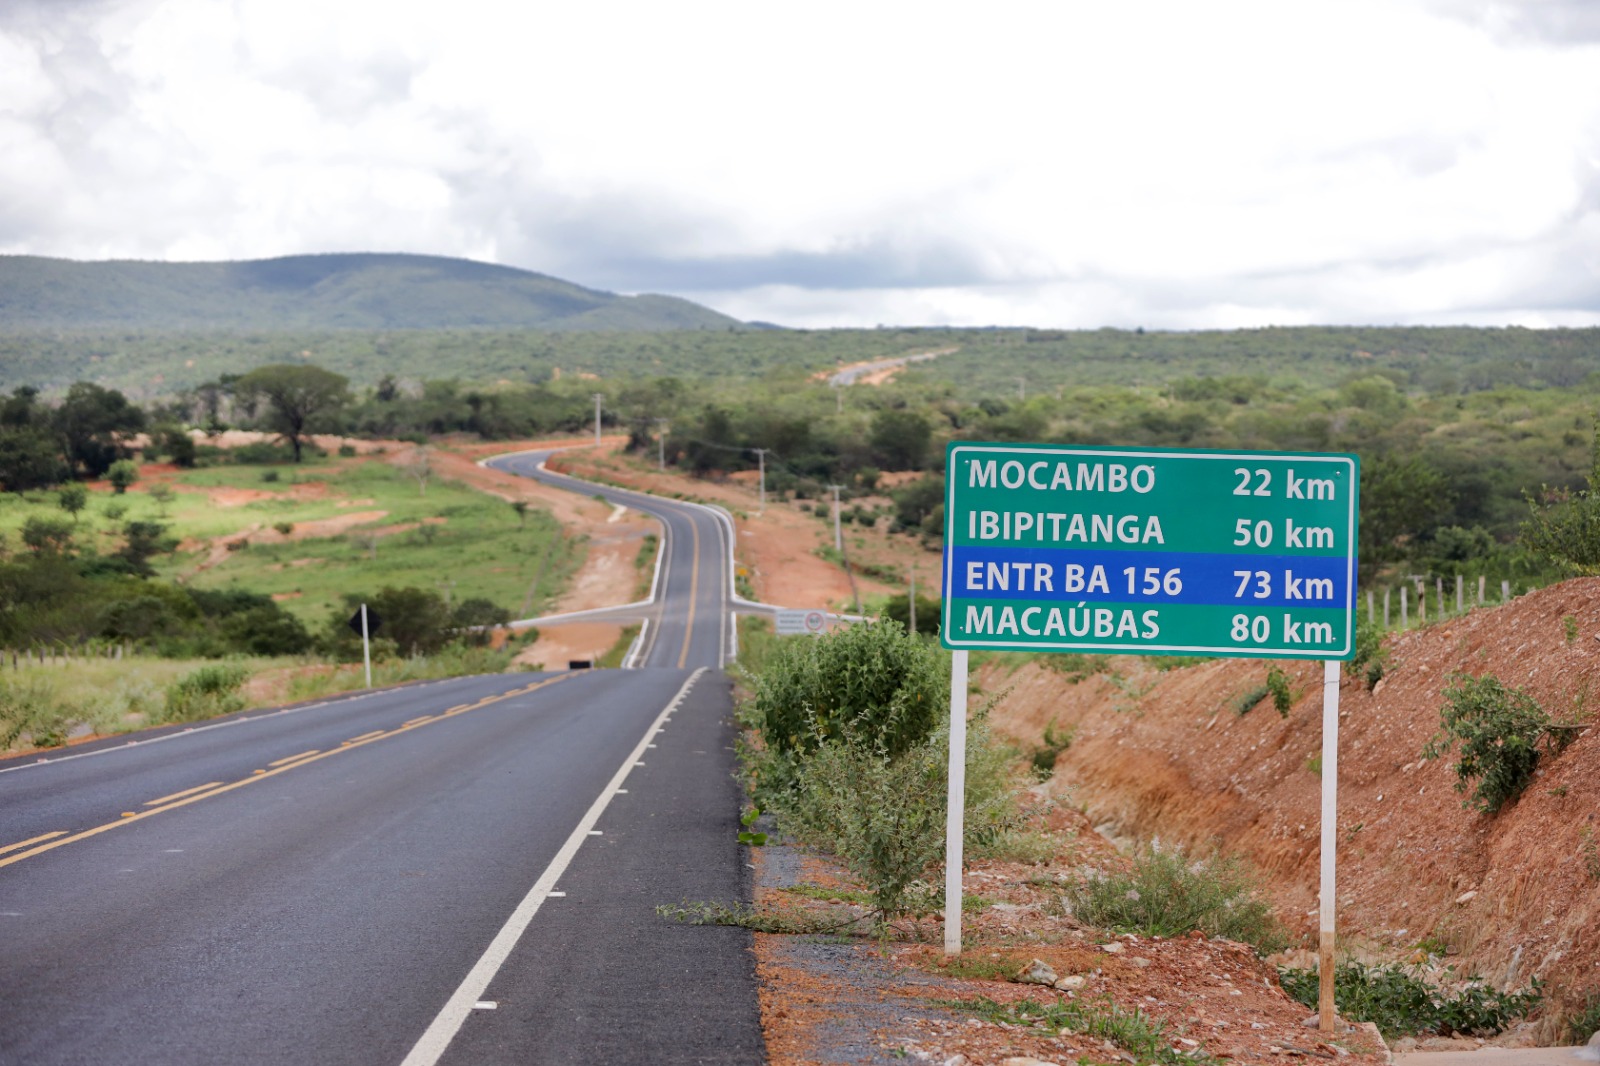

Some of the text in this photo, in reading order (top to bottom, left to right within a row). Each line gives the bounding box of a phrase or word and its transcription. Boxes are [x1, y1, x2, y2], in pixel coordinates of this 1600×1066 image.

[968, 460, 1334, 500] MOCAMBO 22 km
[968, 511, 1333, 547] IBIPITANGA 50 km
[967, 562, 1333, 599] ENTR BA 156 73 km
[965, 601, 1332, 643] MACAÚBAS 80 km
